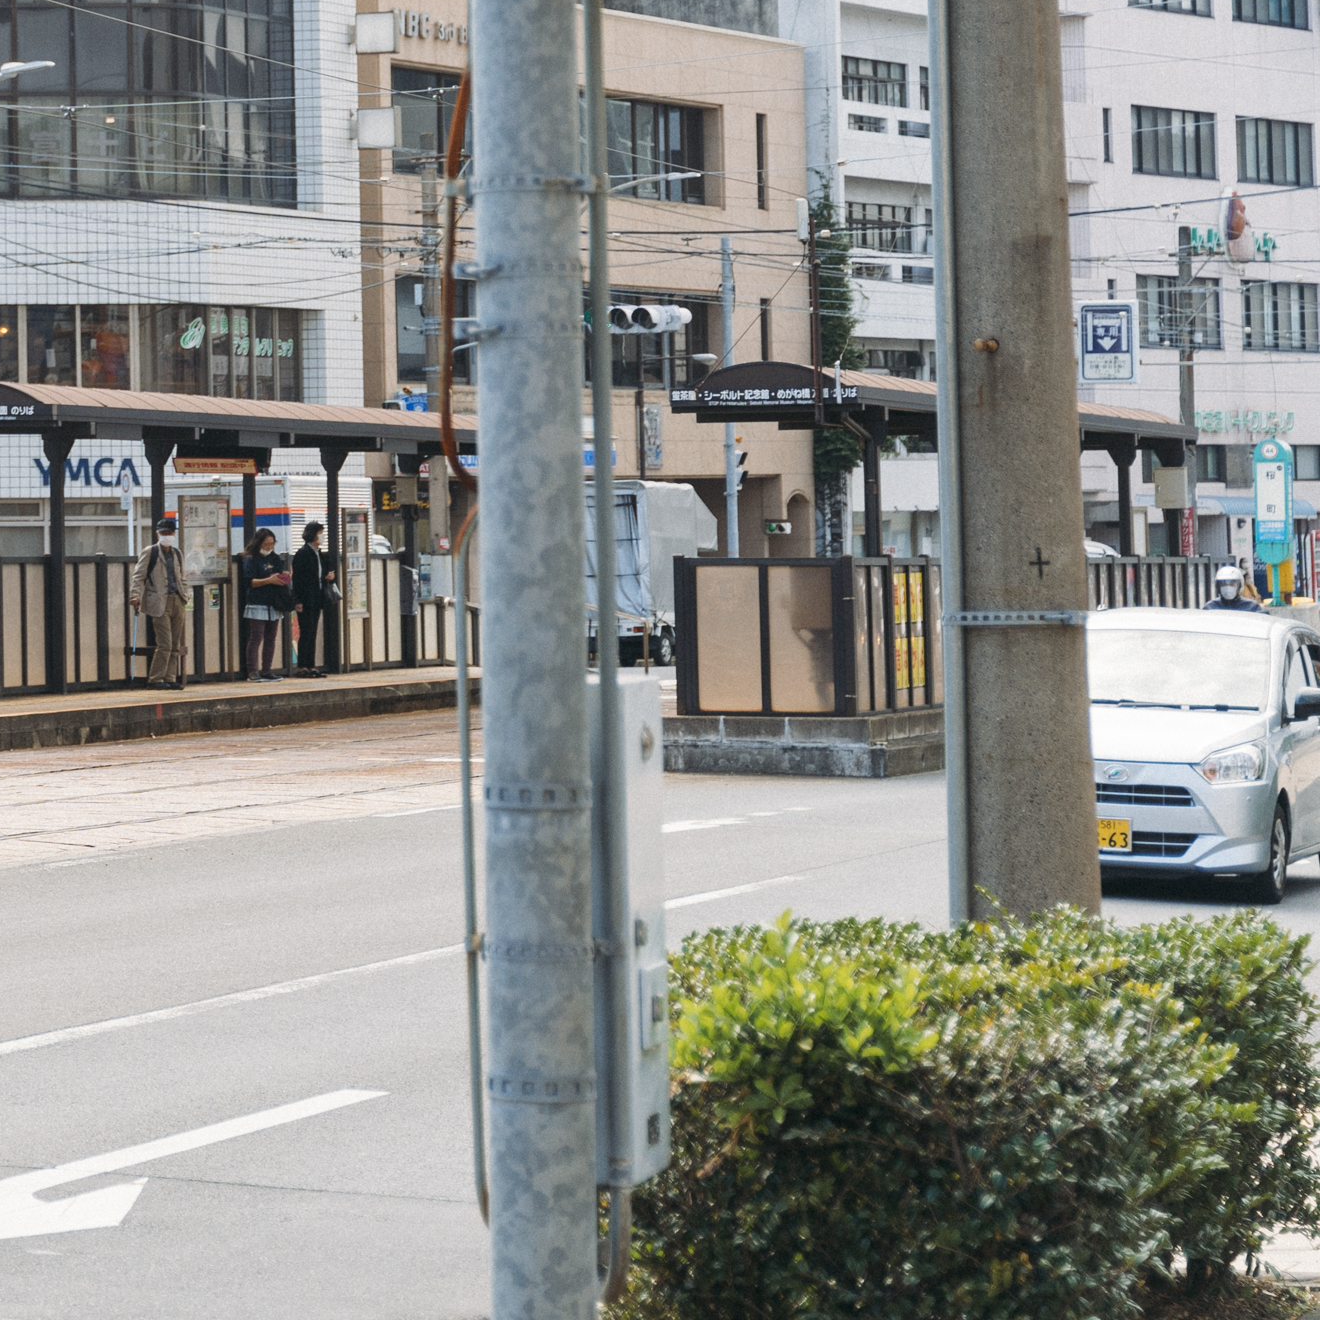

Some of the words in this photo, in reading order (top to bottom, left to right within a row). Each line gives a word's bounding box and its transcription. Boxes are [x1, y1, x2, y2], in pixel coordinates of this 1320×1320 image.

[11, 406, 34, 415] のりば
[33, 457, 141, 487] YMCA
[1266, 471, 1276, 514] 桜町
